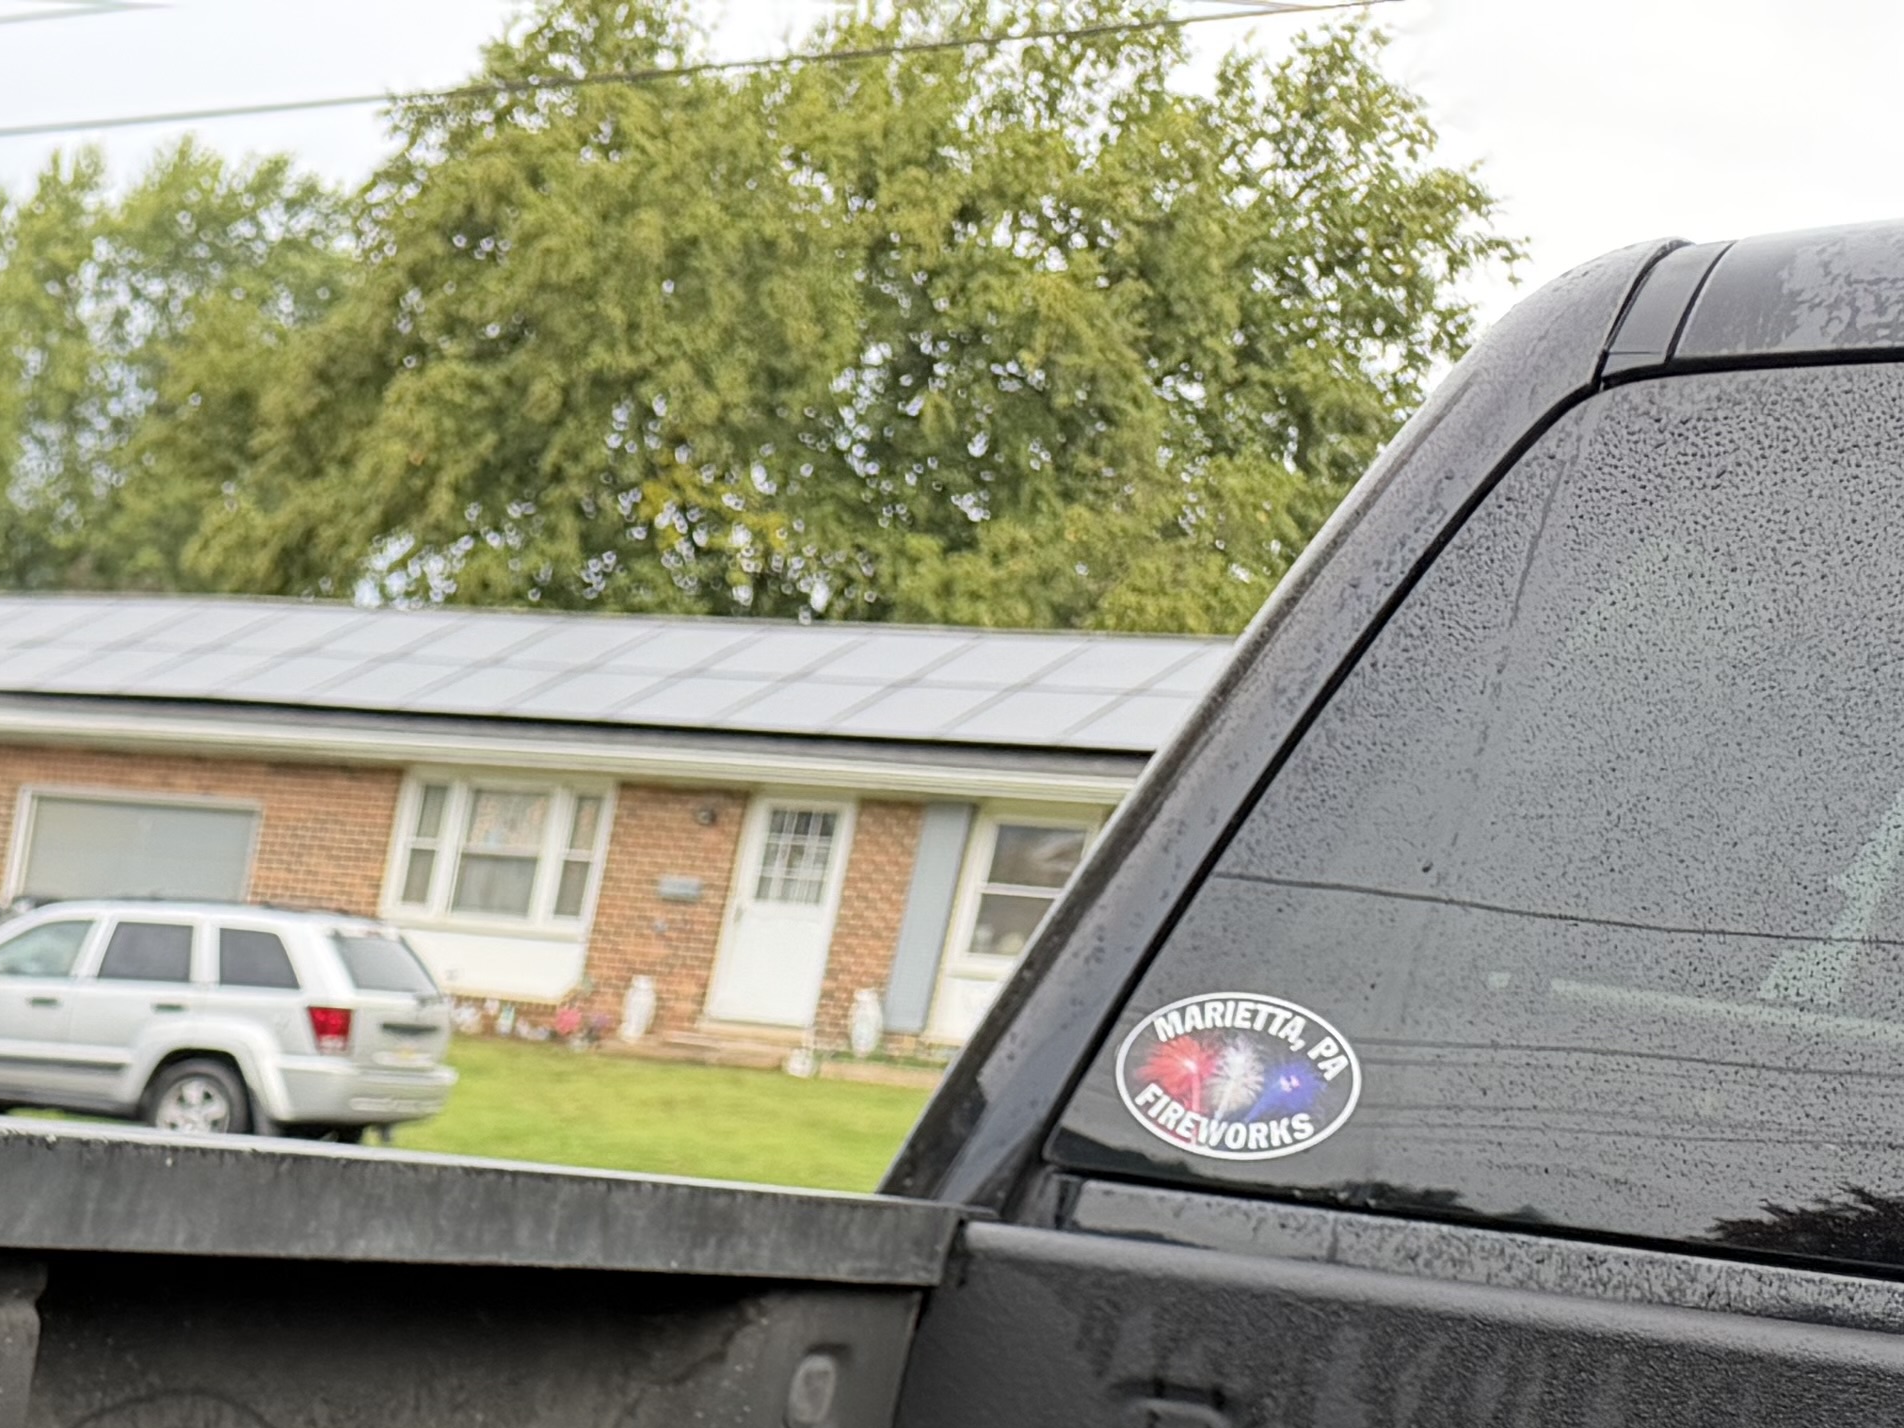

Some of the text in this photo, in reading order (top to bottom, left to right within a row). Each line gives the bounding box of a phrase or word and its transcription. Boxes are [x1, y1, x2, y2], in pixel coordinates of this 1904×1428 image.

[1153, 1000, 1349, 1081] MARIETTA, PA
[1135, 1083, 1315, 1149] FIREWORKS
